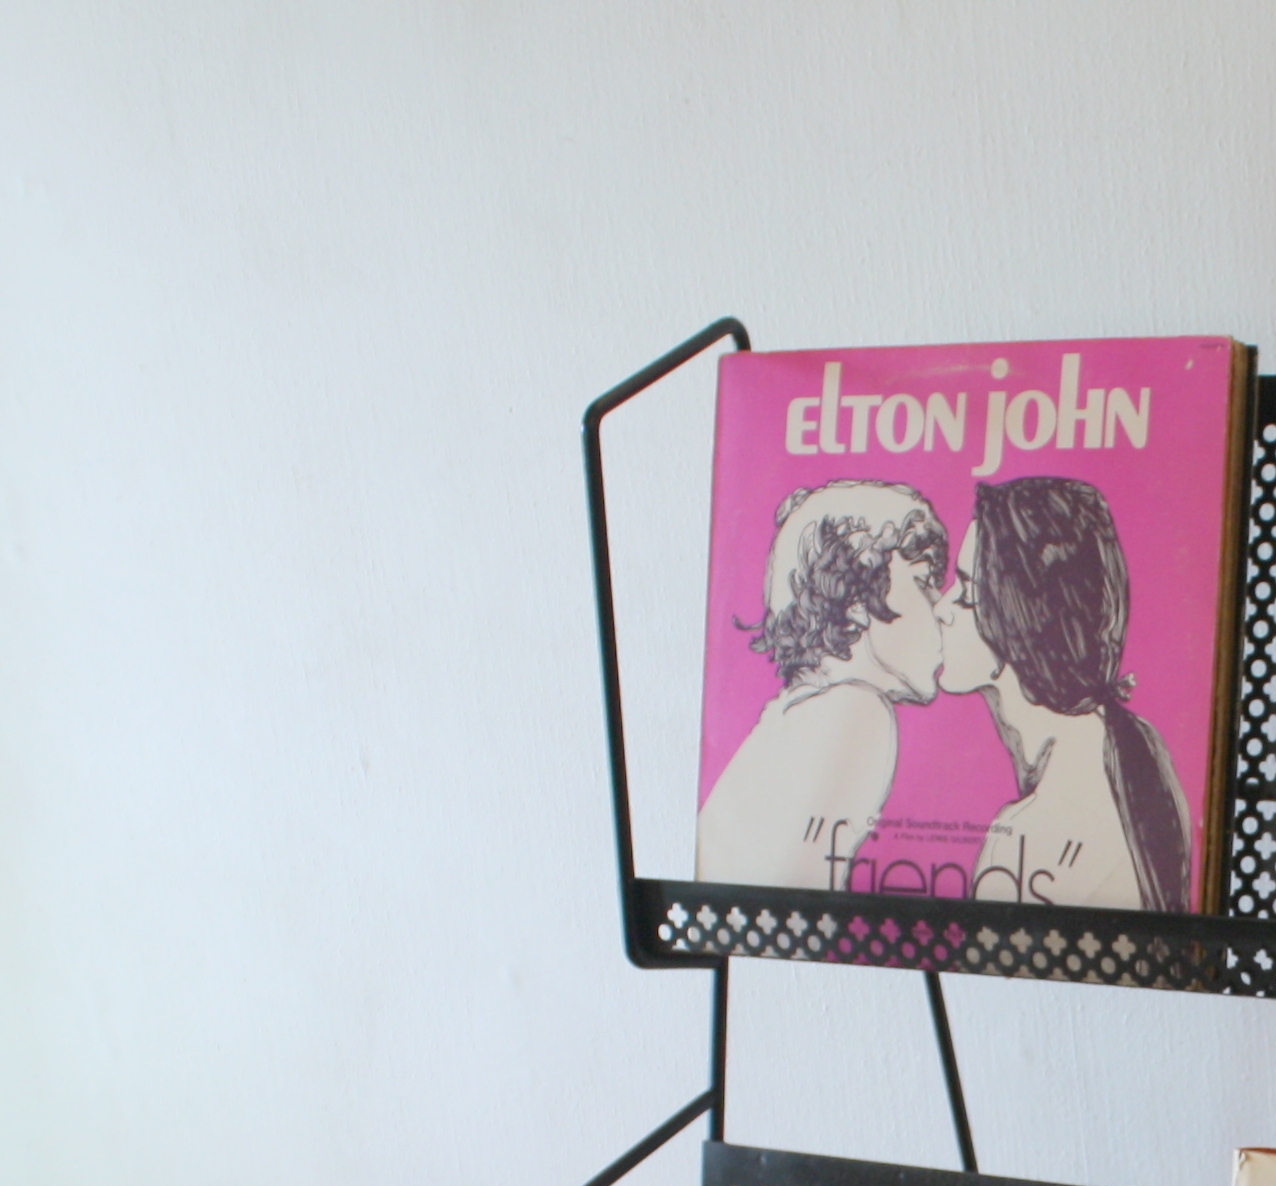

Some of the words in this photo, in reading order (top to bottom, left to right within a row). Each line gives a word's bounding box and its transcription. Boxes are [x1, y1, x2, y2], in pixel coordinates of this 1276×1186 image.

[866, 816, 903, 831] Original
[905, 818, 959, 831] Soundtrack
[962, 821, 1012, 836] Recording
